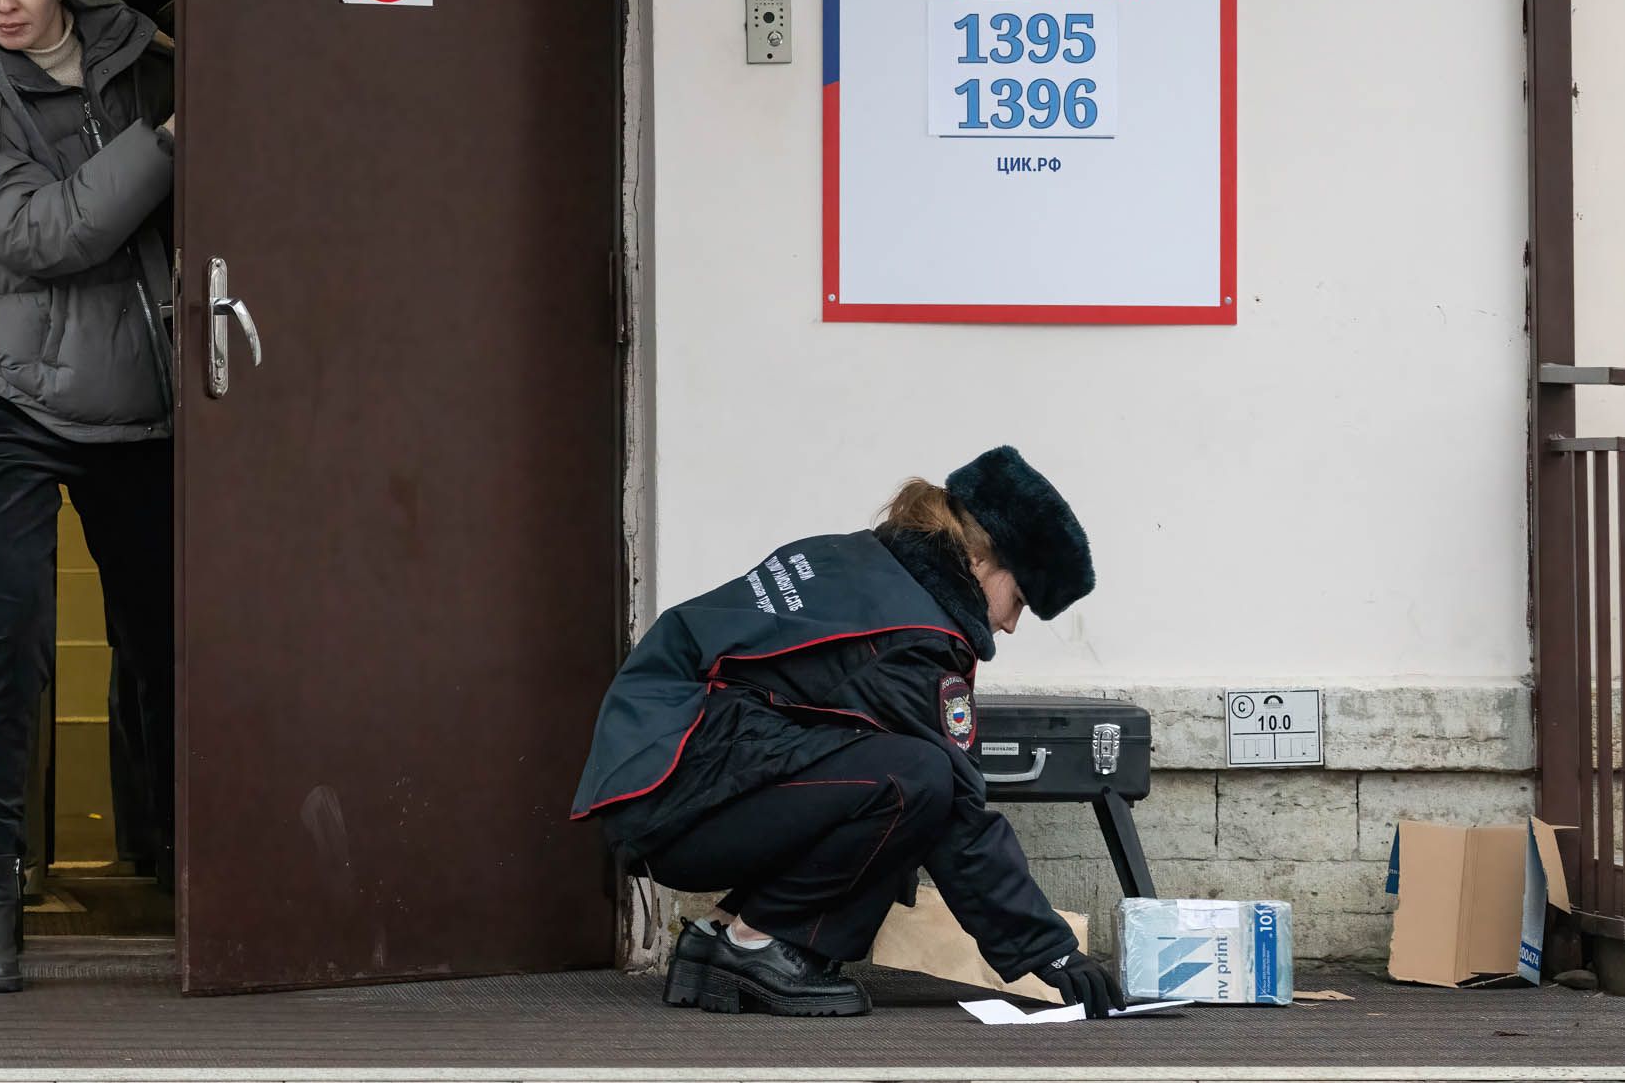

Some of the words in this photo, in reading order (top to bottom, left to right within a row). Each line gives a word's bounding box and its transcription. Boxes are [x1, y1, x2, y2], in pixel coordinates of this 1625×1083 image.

[953, 12, 1097, 65] 1395
[953, 78, 1099, 130] 1396
[996, 156, 1062, 176] ЦИК.РФ
[1257, 714, 1292, 731] 10.0
[1214, 935, 1232, 974] print
[1519, 946, 1539, 967] 00474
[1217, 980, 1229, 1000] nv
